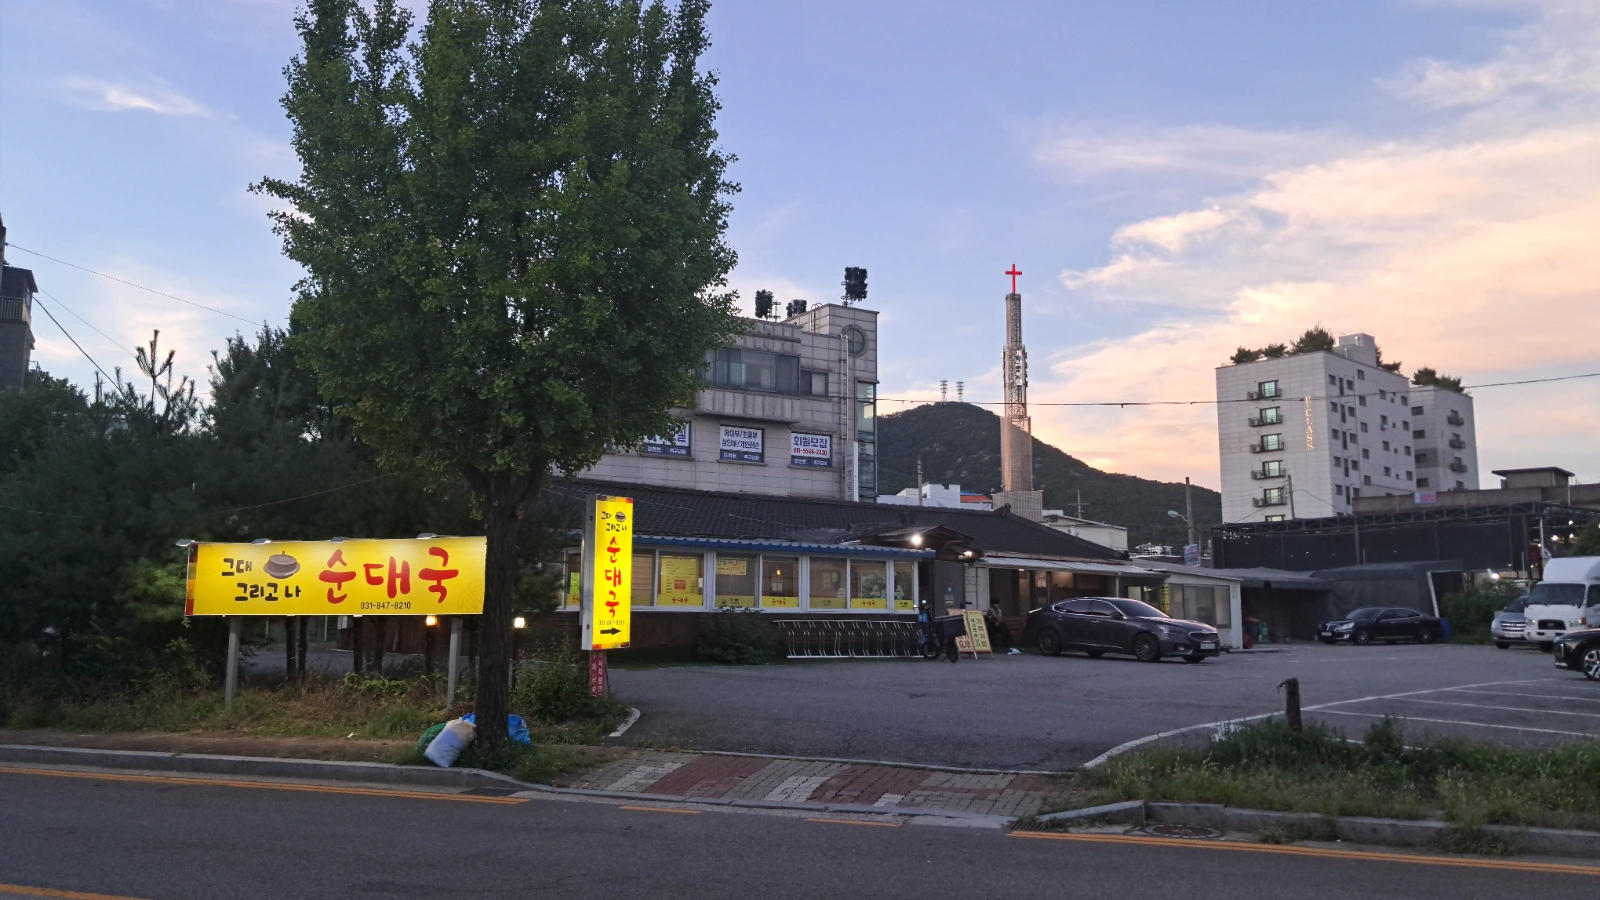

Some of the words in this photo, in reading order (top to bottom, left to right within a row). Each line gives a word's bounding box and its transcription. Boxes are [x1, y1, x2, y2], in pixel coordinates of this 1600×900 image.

[793, 435, 828, 449] 회원모집
[221, 557, 252, 577] 그대
[318, 546, 460, 605] 순대국
[605, 536, 621, 618] 순대국
[234, 582, 279, 602] 그리고
[284, 585, 302, 599] 나
[360, 601, 412, 610] 031-847-8210
